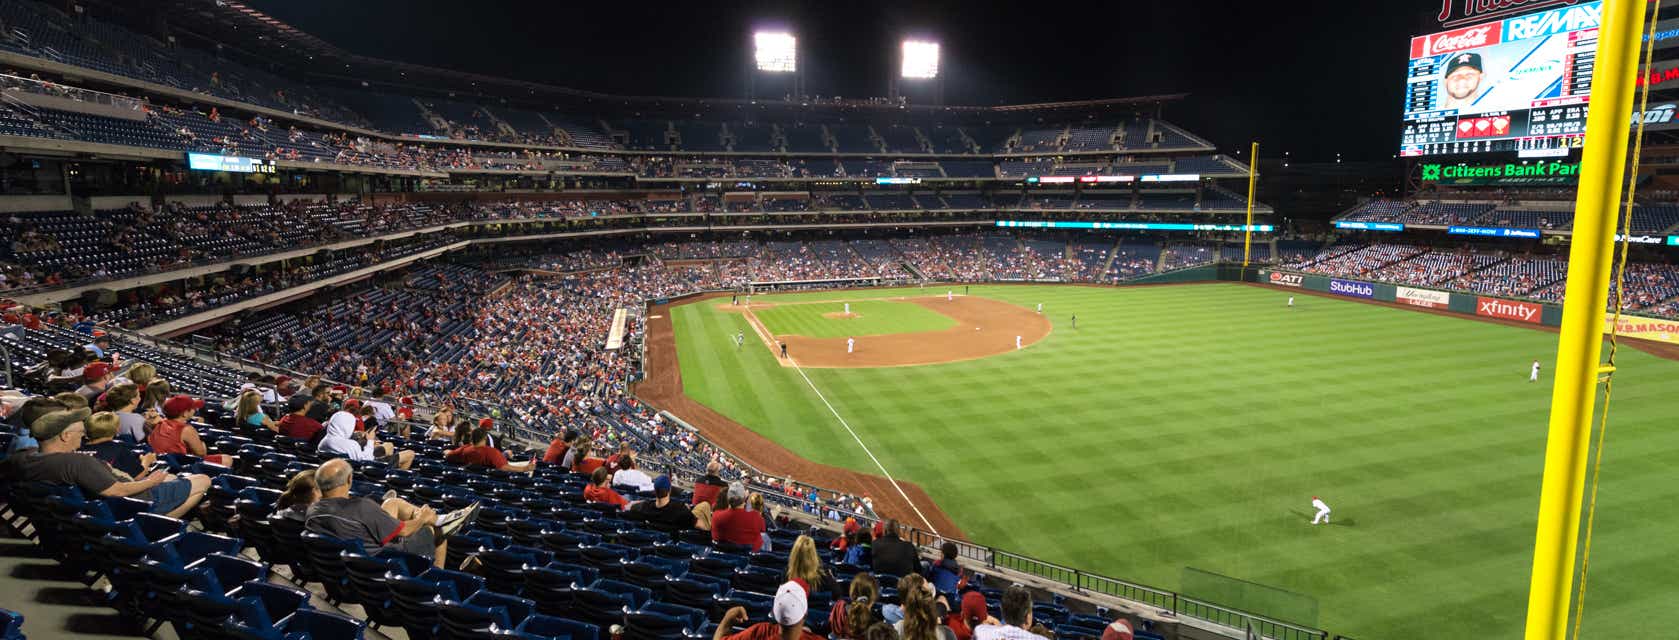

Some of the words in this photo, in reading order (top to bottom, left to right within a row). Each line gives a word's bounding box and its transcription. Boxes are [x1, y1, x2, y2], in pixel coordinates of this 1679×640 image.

[1508, 4, 1602, 41] RE/MAX
[1433, 26, 1491, 52] Coca-Cola
[1560, 137, 1567, 148] 1
[1572, 137, 1582, 148] 2
[1443, 164, 1501, 178] Citizens
[1505, 163, 1545, 177] Bank
[1280, 274, 1303, 284] ATI
[1330, 280, 1373, 296] StubHub
[1480, 300, 1537, 321] xfinity
